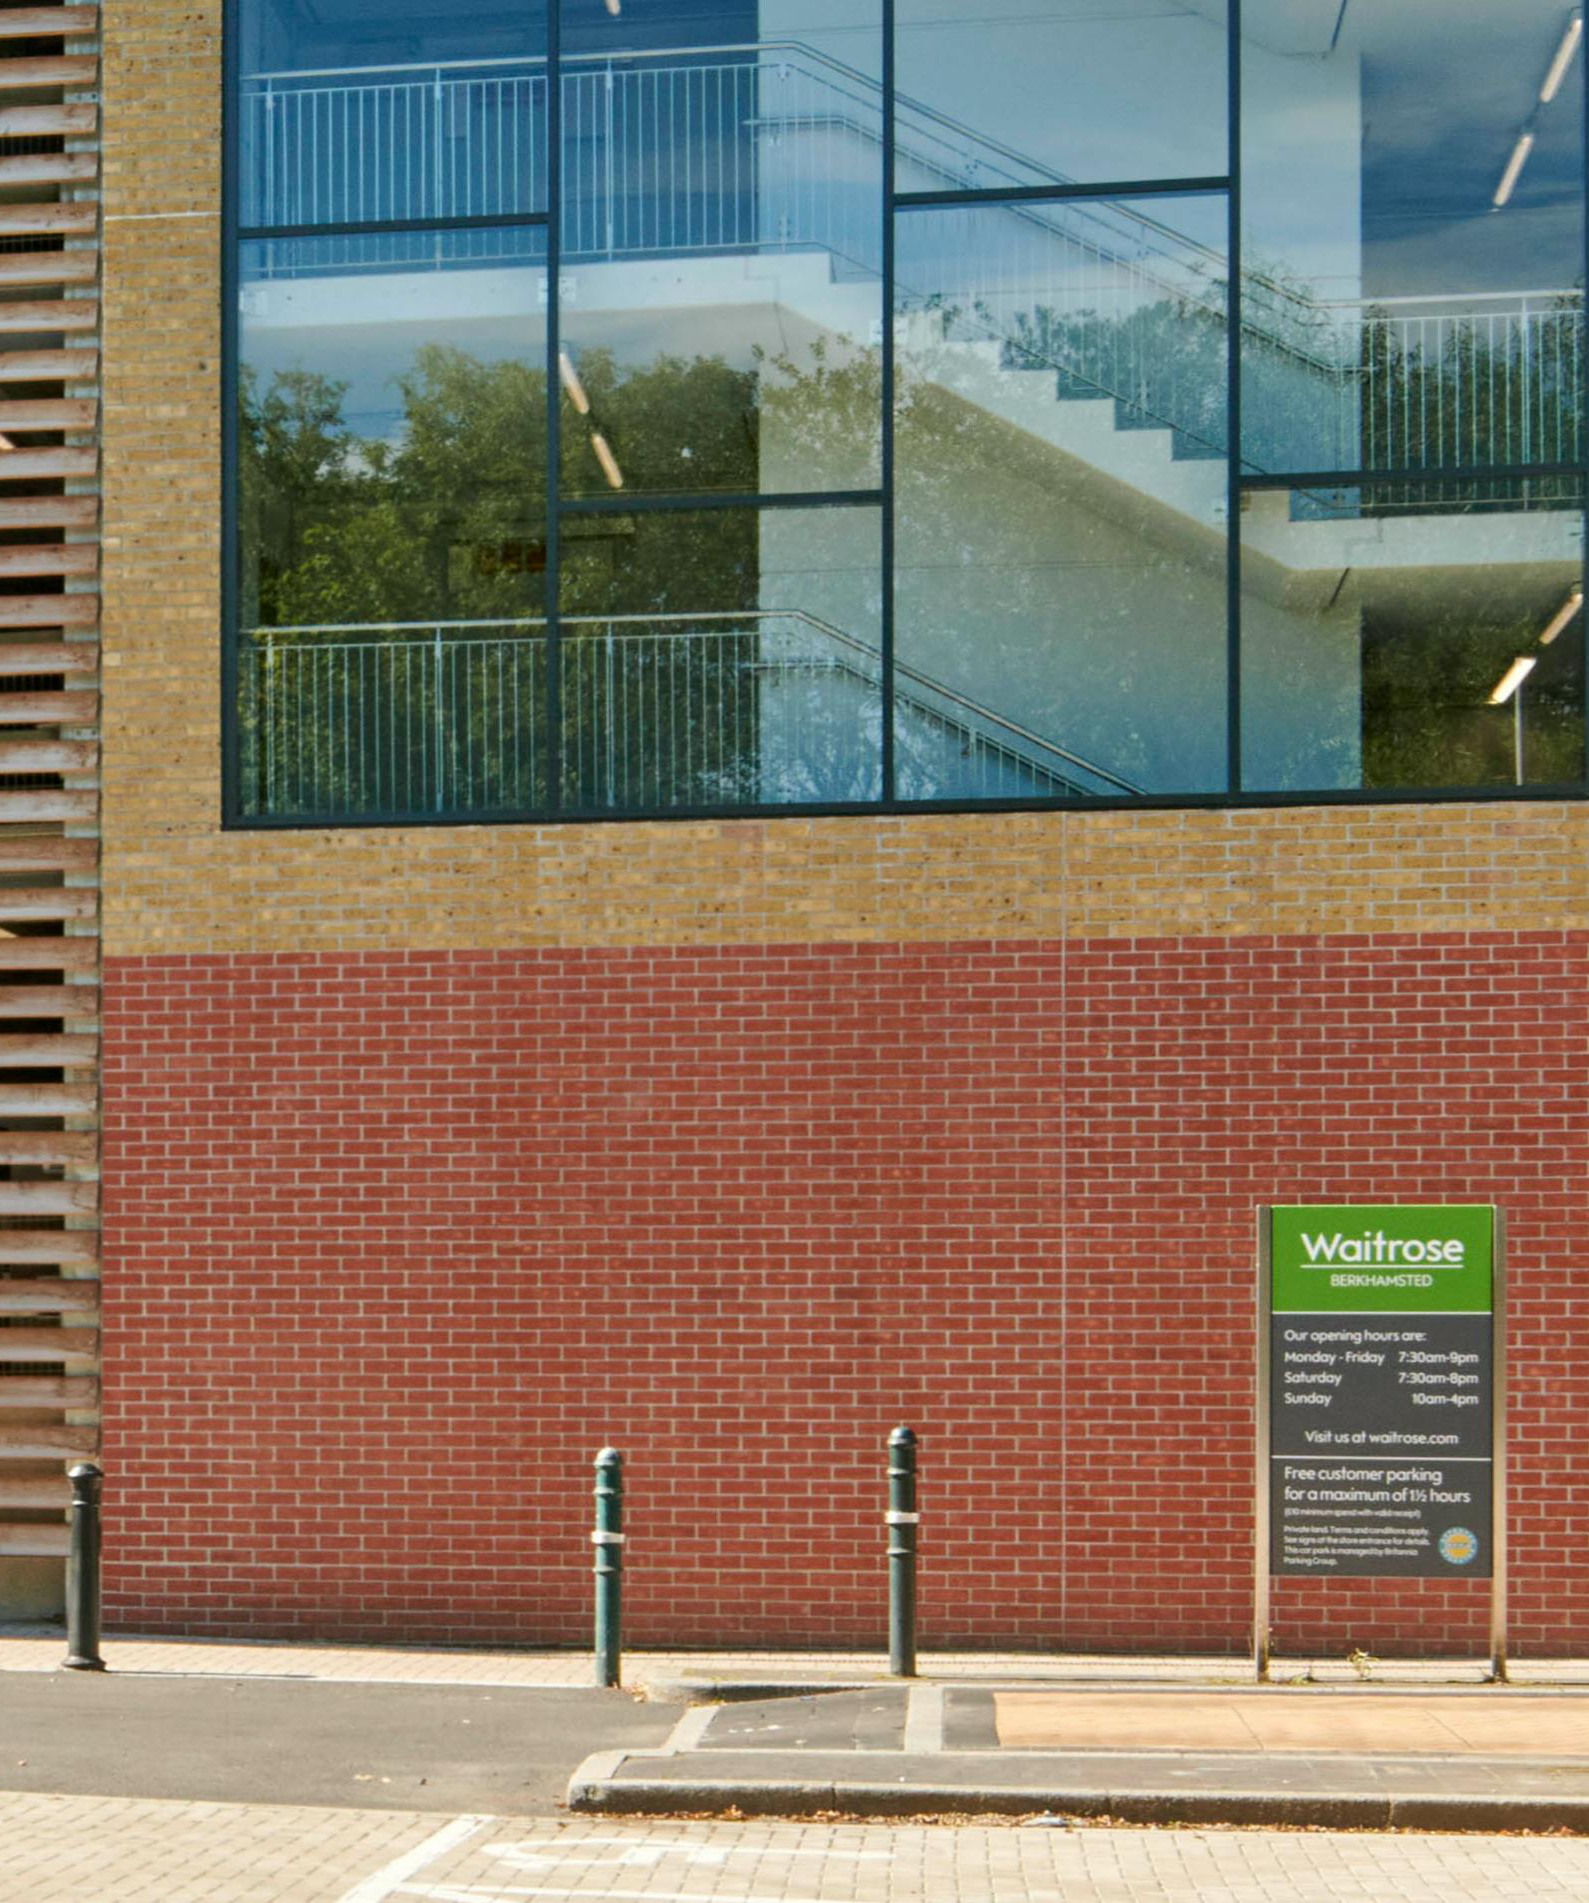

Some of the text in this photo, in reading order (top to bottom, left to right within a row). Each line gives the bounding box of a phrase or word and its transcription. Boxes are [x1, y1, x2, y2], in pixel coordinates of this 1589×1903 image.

[1300, 1231, 1464, 1262] Waitrose
[1330, 1274, 1433, 1287] BERKHAMSTED
[1284, 1330, 1427, 1344] Our opening hours are:
[1284, 1352, 1336, 1366] Monday
[1345, 1352, 1385, 1366] Friday
[1398, 1352, 1479, 1366] 7:30am-9pm
[1284, 1372, 1479, 1386] Saturday 7:30am-8pm
[1284, 1392, 1479, 1407] Sunday 10am-4pm
[1304, 1431, 1459, 1445] Visit us at waitrose.com
[1284, 1467, 1443, 1485] Free customer parking
[1285, 1486, 1305, 1500] for
[1307, 1491, 1318, 1501] a
[1321, 1487, 1390, 1502] maximum
[1392, 1488, 1407, 1502] of
[1430, 1490, 1471, 1503] hours
